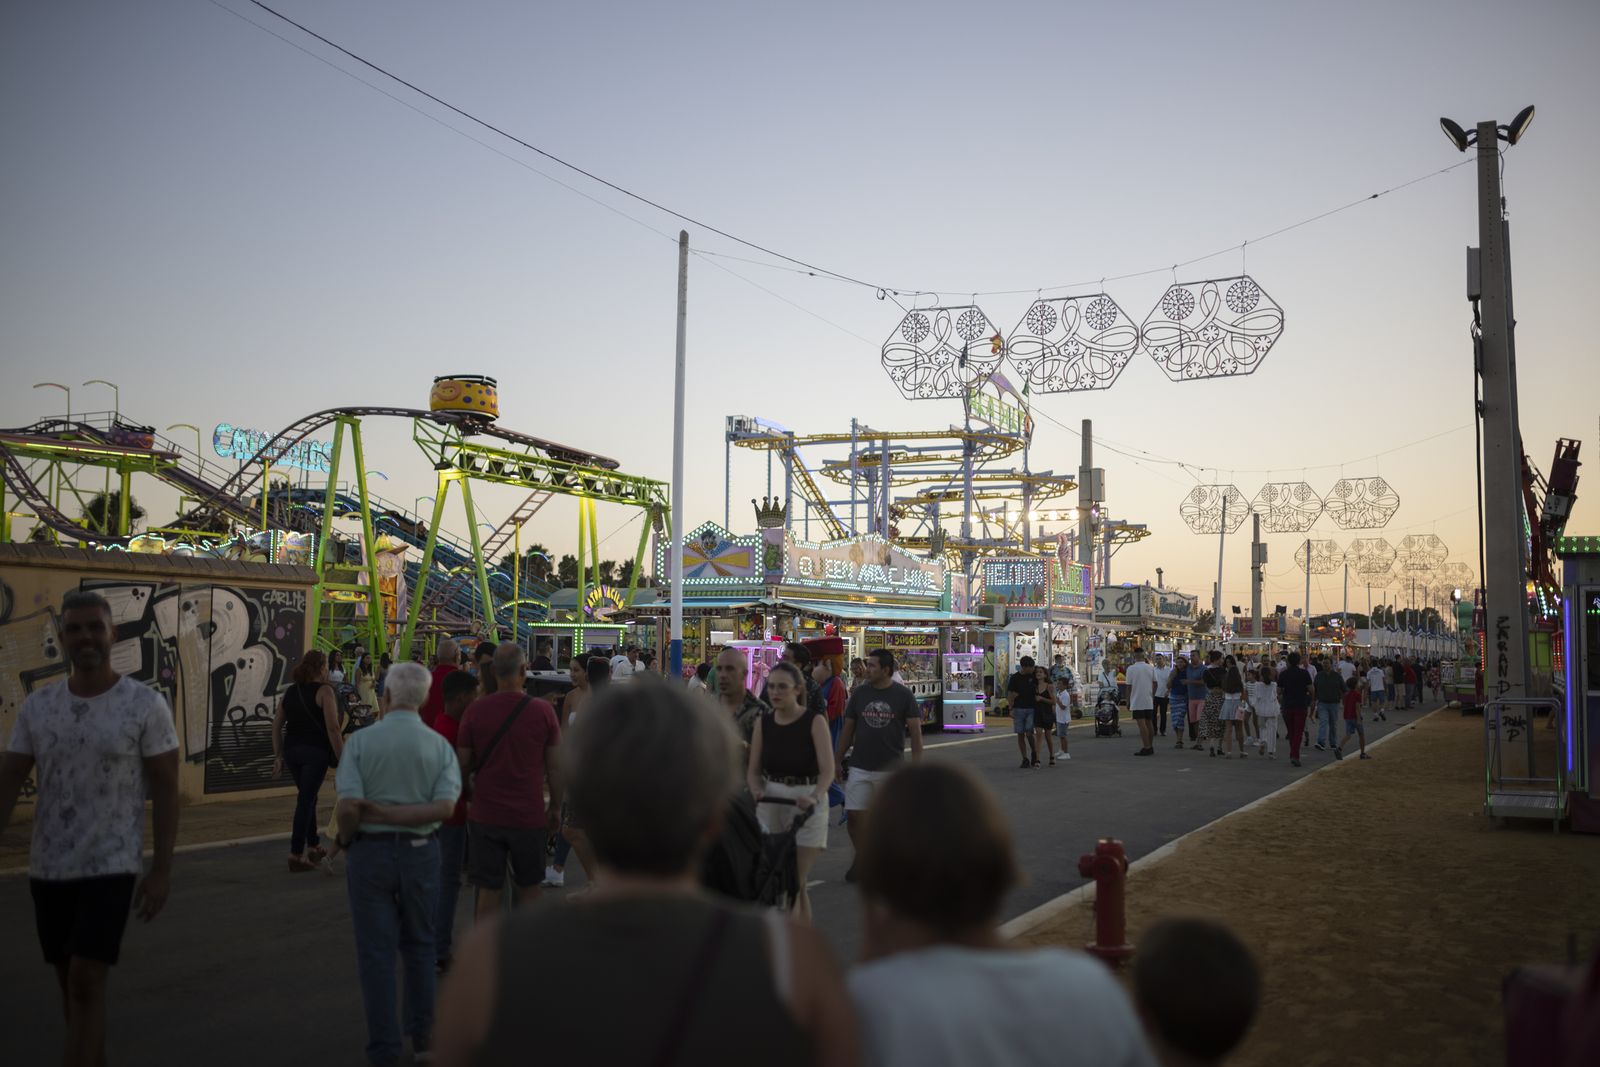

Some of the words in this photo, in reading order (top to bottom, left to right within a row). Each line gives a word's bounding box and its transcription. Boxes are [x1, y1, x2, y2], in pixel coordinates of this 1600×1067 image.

[798, 556, 855, 580] QUEEN
[857, 562, 940, 591] MACHINE
[986, 563, 1044, 586] HELADOS
